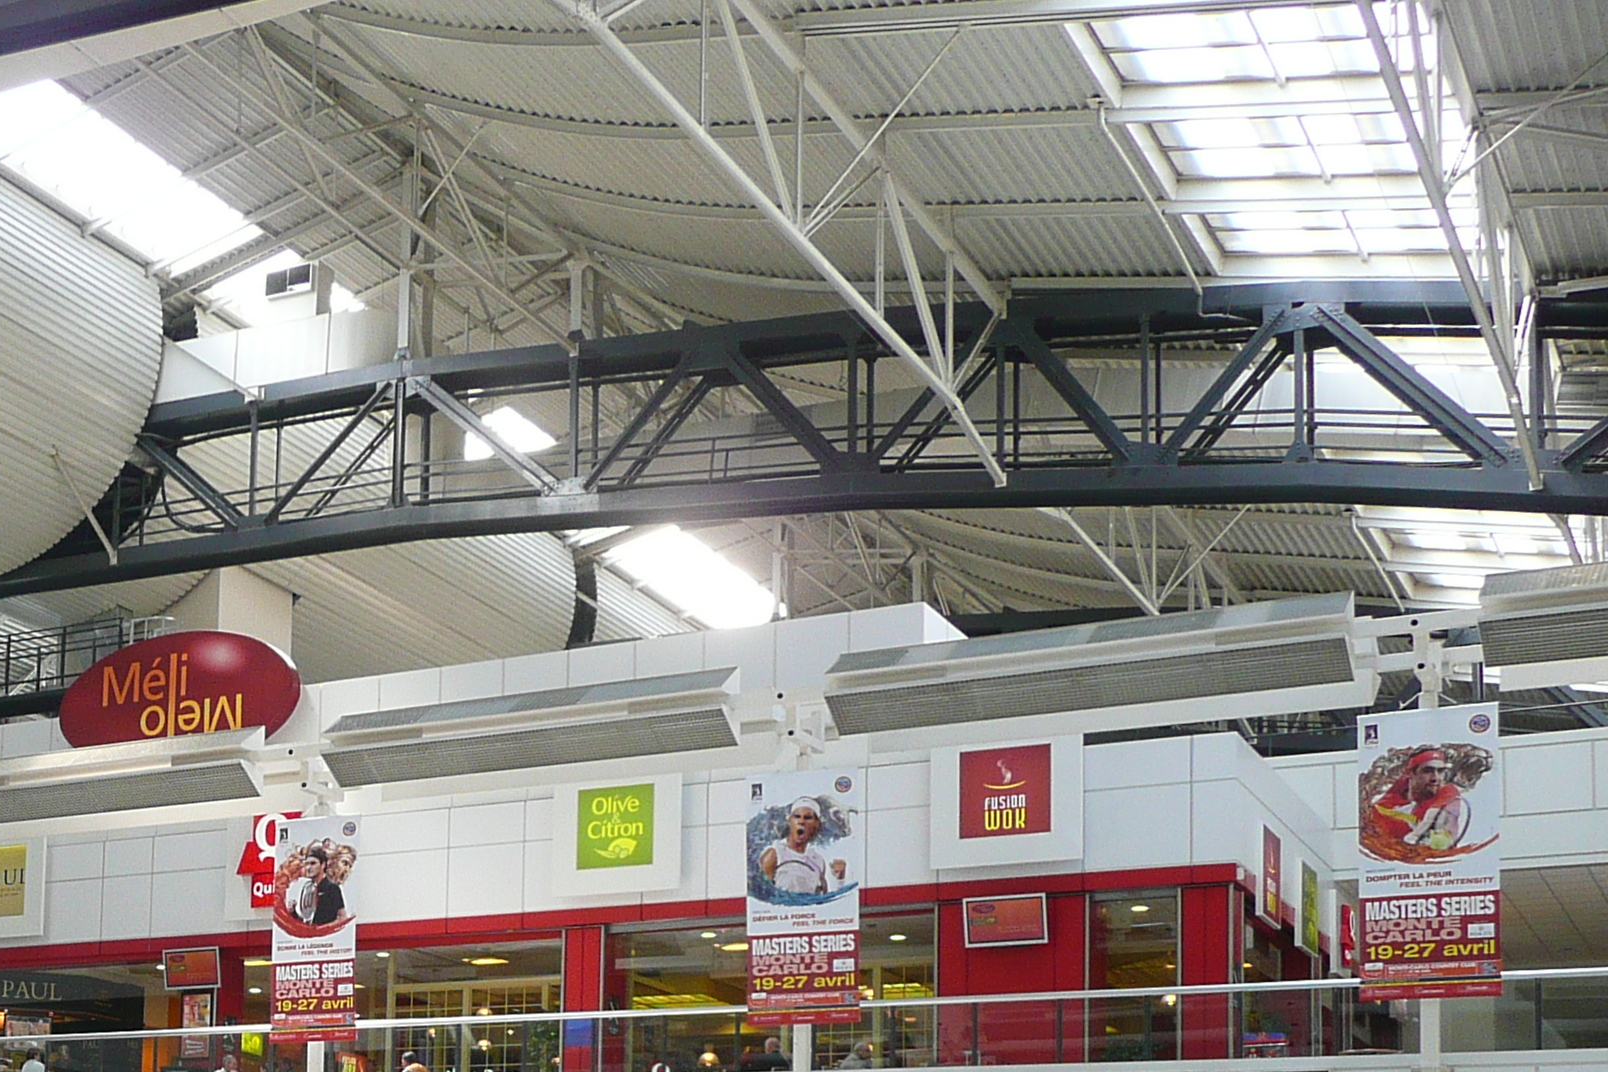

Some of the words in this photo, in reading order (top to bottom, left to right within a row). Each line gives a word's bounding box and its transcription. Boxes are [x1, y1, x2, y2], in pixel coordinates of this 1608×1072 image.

[102, 653, 188, 710] Méli
[592, 794, 640, 815] Olive
[611, 812, 622, 824] &
[984, 808, 1027, 831] WOK
[587, 819, 644, 839] Citron
[1365, 873, 1410, 883] DOMPTER
[1412, 872, 1425, 880] LA
[1426, 870, 1452, 879] PEUR
[1425, 879, 1443, 887] THE
[1445, 876, 1494, 886] INTENSITY
[1365, 897, 1438, 921] MASTERS
[1440, 895, 1495, 918] SERIES
[1365, 916, 1462, 932] MONTE
[752, 936, 810, 956] MASTERS
[812, 933, 855, 953] SERIES
[1365, 928, 1462, 944] CARLO
[1366, 943, 1436, 960] 19-27
[1443, 939, 1496, 957] avril
[752, 952, 829, 966] MONTE
[275, 964, 320, 981] MASTERS
[321, 961, 354, 979] SERIES
[752, 963, 829, 976] CARLO
[2, 979, 63, 1001] PAUL
[275, 978, 335, 991] MONTE
[753, 976, 808, 991] 19-27
[814, 972, 855, 988] avril
[275, 987, 335, 999] CARLO
[275, 998, 318, 1012] 19-27
[322, 996, 354, 1010] avril
